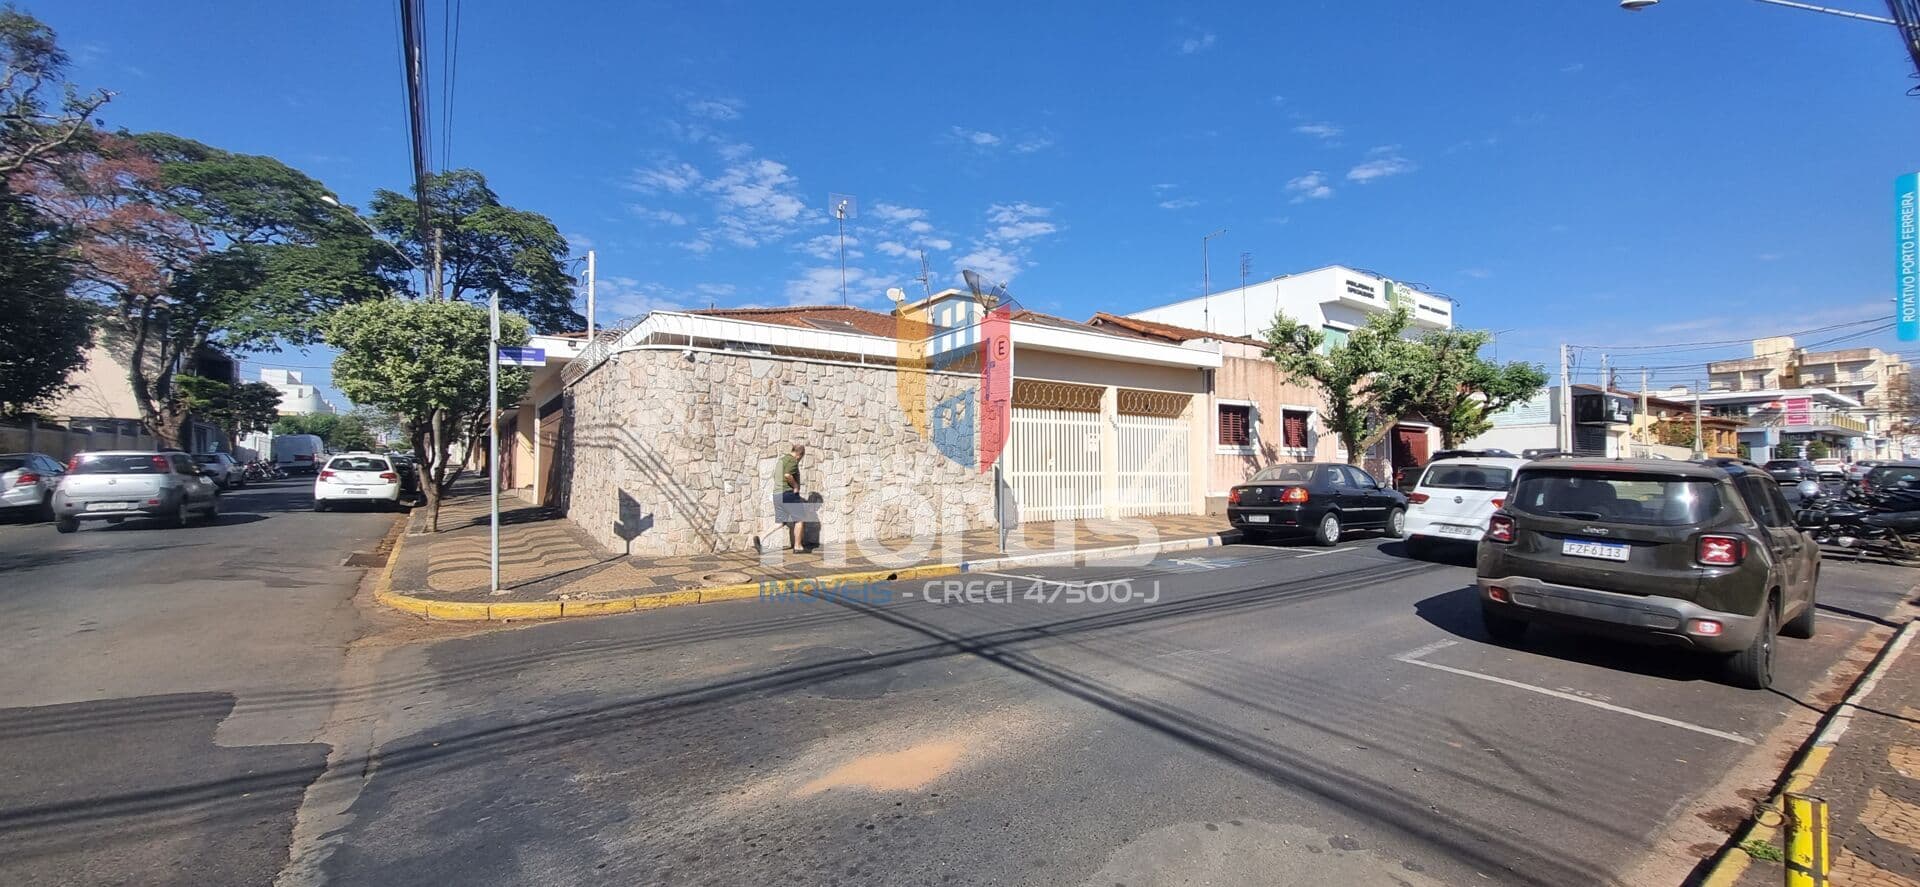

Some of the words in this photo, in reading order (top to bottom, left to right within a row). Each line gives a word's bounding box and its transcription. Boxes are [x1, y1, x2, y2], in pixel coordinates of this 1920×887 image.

[1902, 191, 1915, 240] FERREIRA
[1903, 241, 1915, 275] PORTO
[1903, 275, 1915, 323] ROTATIVO
[998, 341, 1005, 356] E
[1582, 525, 1609, 536] Jeep
